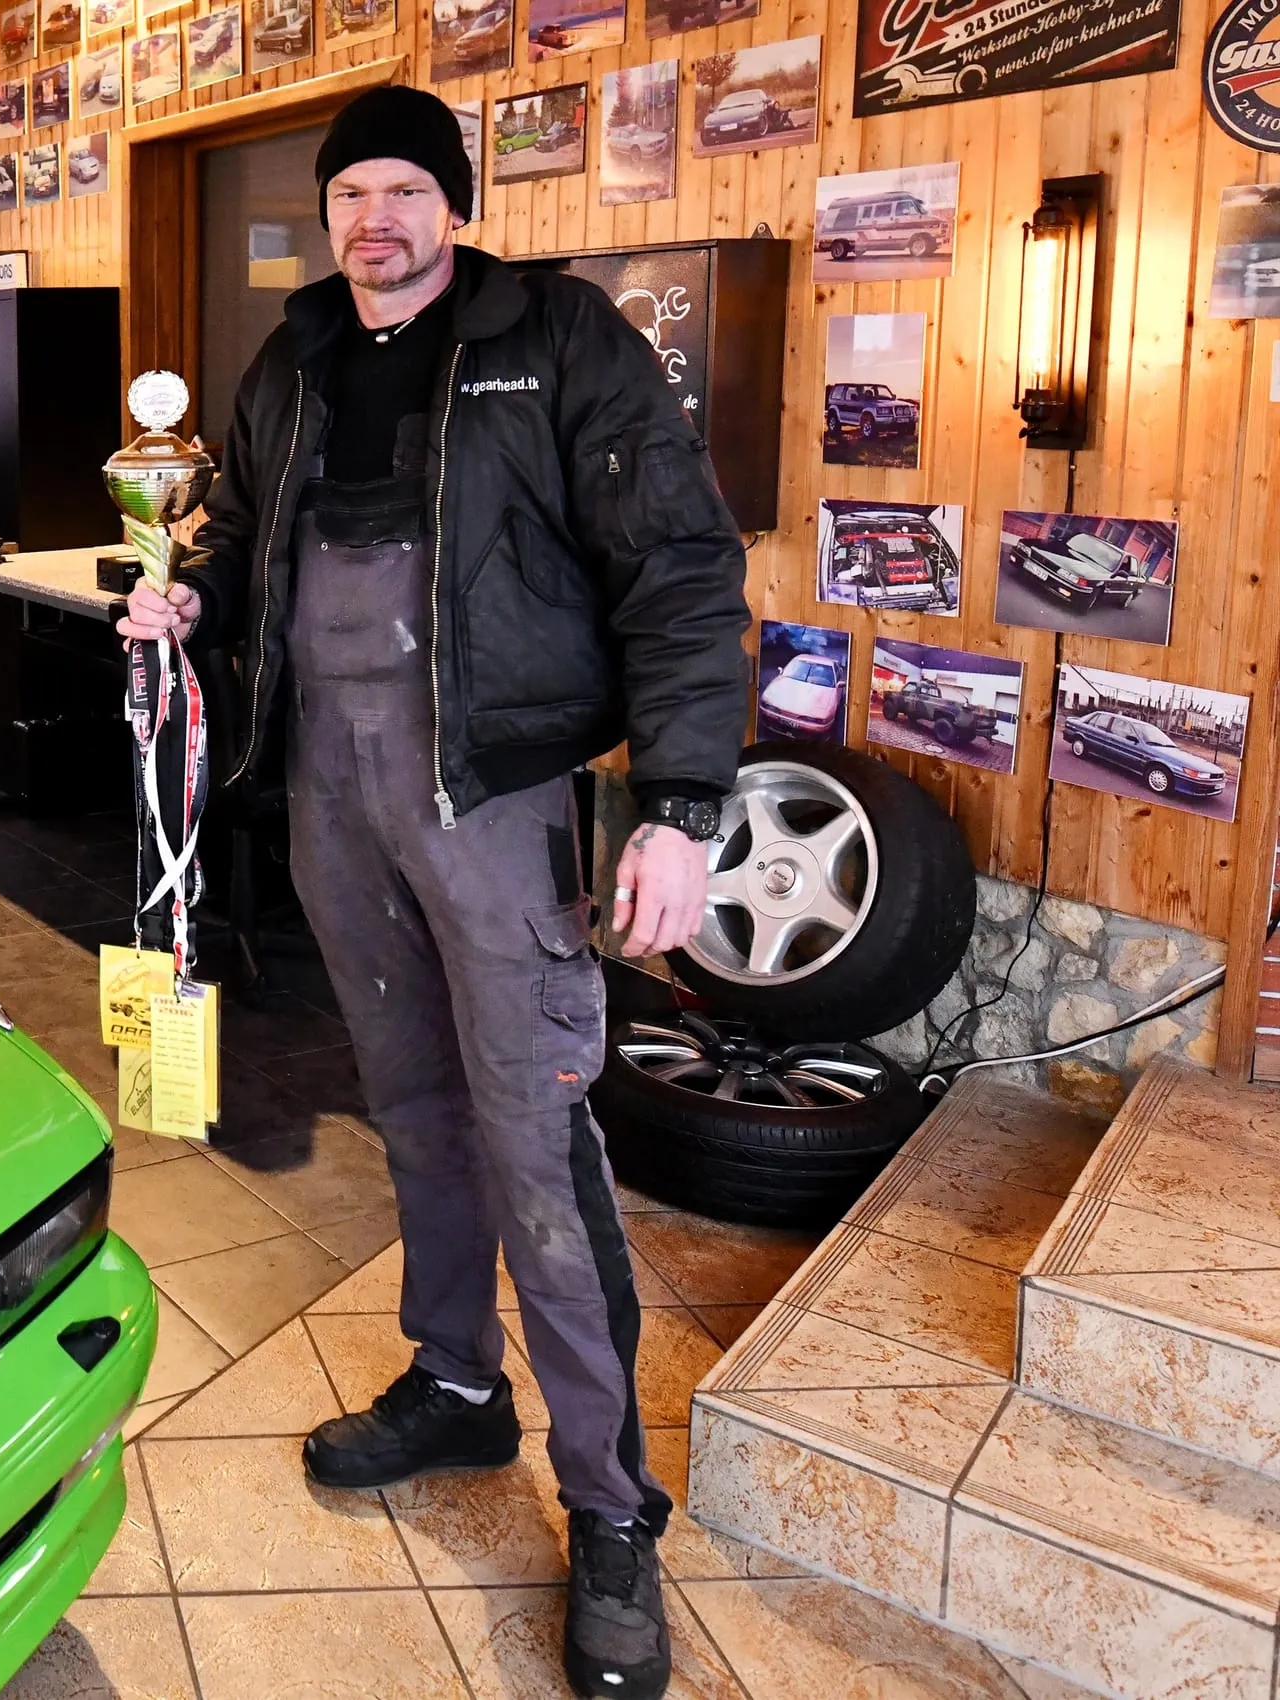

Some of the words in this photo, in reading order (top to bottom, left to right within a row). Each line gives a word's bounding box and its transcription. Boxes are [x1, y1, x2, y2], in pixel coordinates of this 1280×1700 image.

[964, 18, 987, 38] 24
[989, 0, 1052, 28] Stund
[1235, 99, 1257, 120] 24
